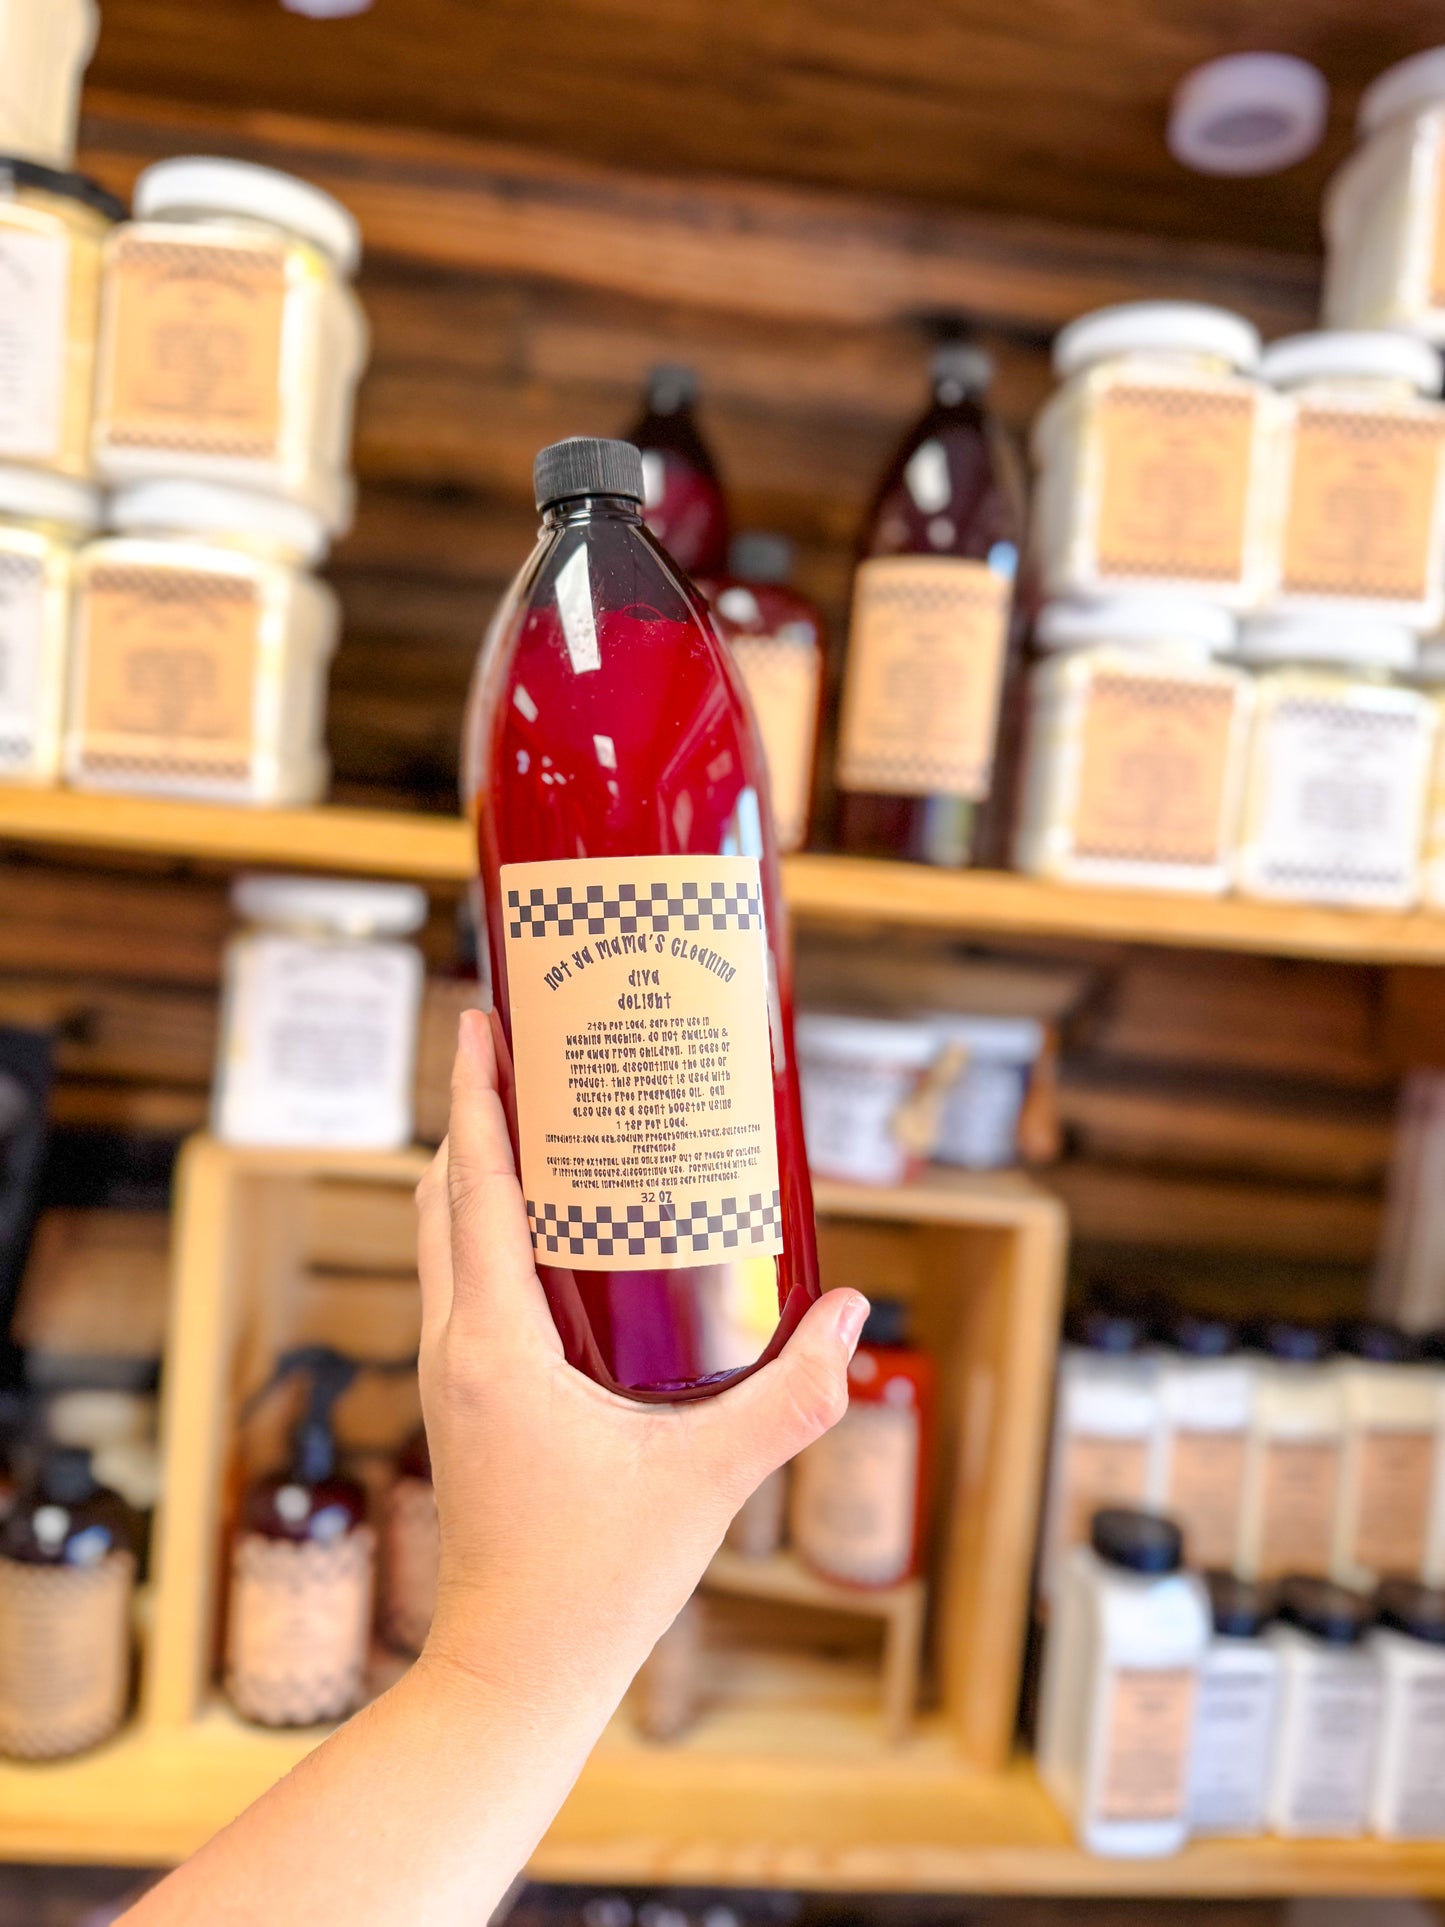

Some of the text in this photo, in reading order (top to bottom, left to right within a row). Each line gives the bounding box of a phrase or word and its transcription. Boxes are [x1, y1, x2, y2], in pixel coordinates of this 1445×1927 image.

[722, 1028, 728, 1037] &
[616, 1120, 621, 1130] 1
[641, 1192, 655, 1203] 32
